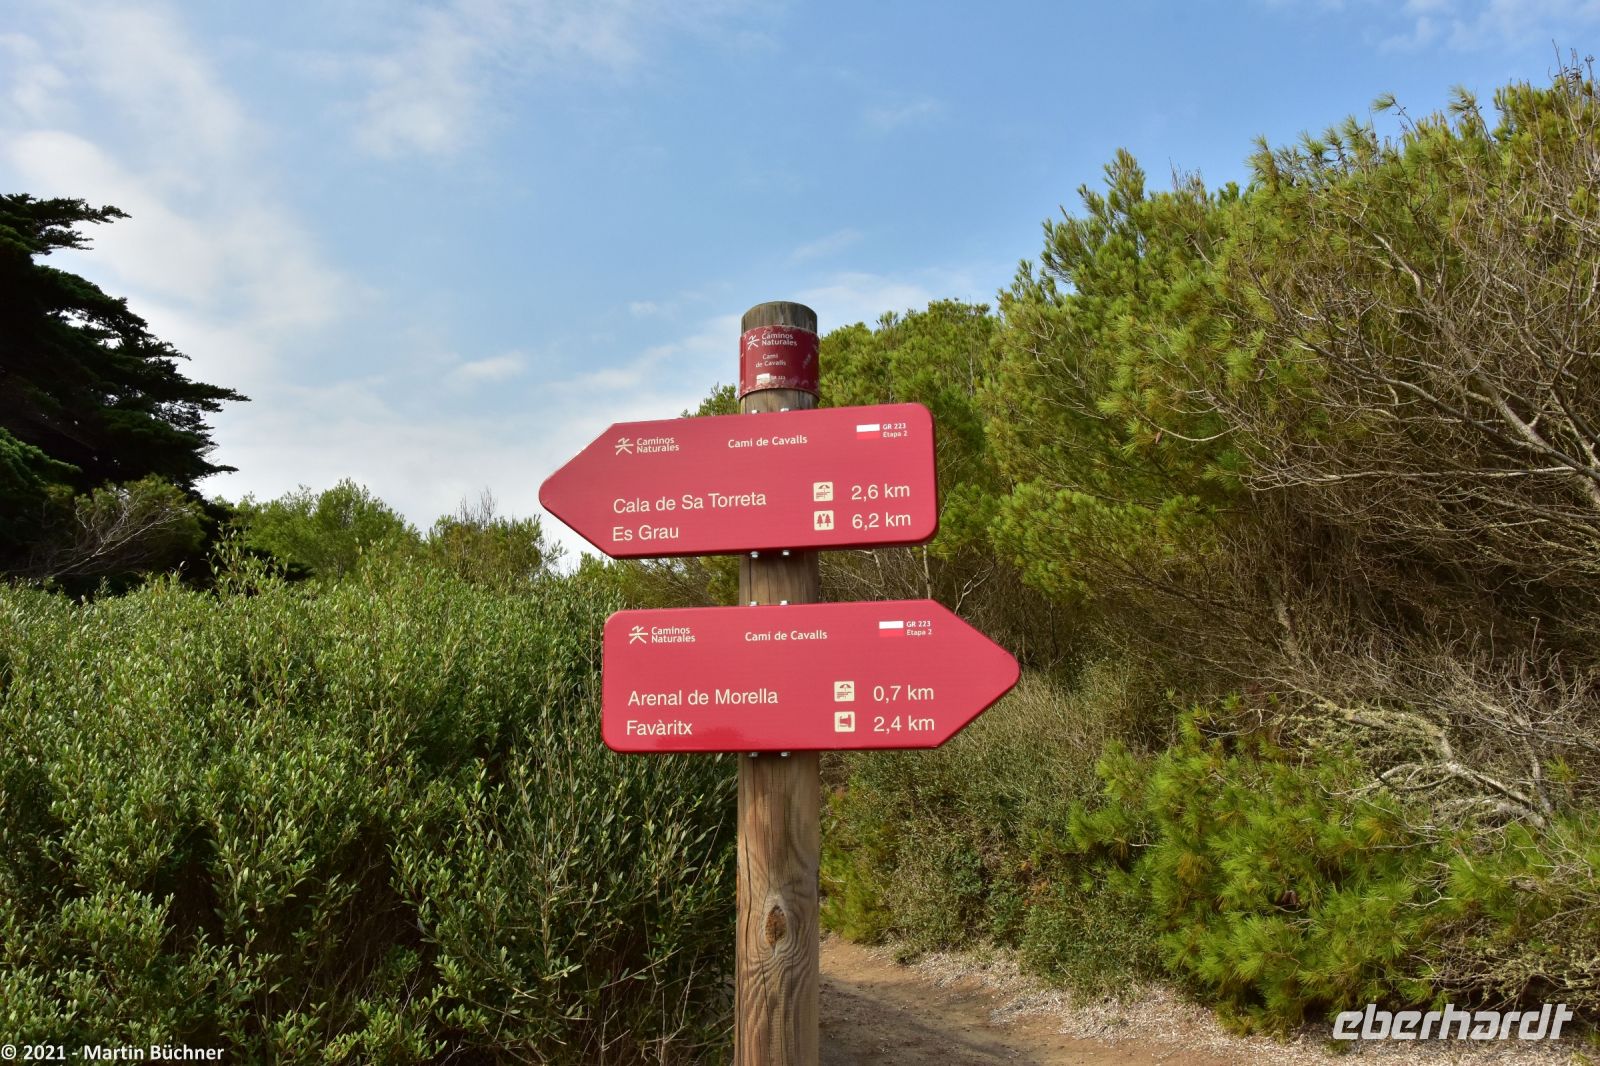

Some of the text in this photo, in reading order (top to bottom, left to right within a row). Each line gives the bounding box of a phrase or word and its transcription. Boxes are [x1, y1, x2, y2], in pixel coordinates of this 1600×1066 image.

[761, 332, 794, 340] Caminos
[761, 339, 798, 347] Naturales
[882, 422, 907, 431] GR 223
[755, 437, 770, 447] de
[771, 434, 809, 446] Cavalls
[882, 431, 901, 439] Etapa
[636, 436, 676, 446] Caminos
[636, 444, 680, 454] Naturales
[851, 483, 911, 502] 2,6 km
[613, 491, 767, 514] Cala de Sa Torreta
[851, 511, 912, 531] 6,2 km
[612, 524, 679, 542] Es Grau
[905, 620, 931, 628] GR 223
[650, 625, 691, 635] Caminos
[773, 630, 788, 641] de
[789, 629, 829, 641] Cavalls
[906, 628, 933, 638] Etapa 2
[650, 633, 696, 644] Naturales
[627, 687, 779, 707] Arenal de Morella
[873, 684, 935, 704] 0,7 km
[626, 719, 694, 736] Favàritx
[873, 714, 935, 735] 2,4 km
